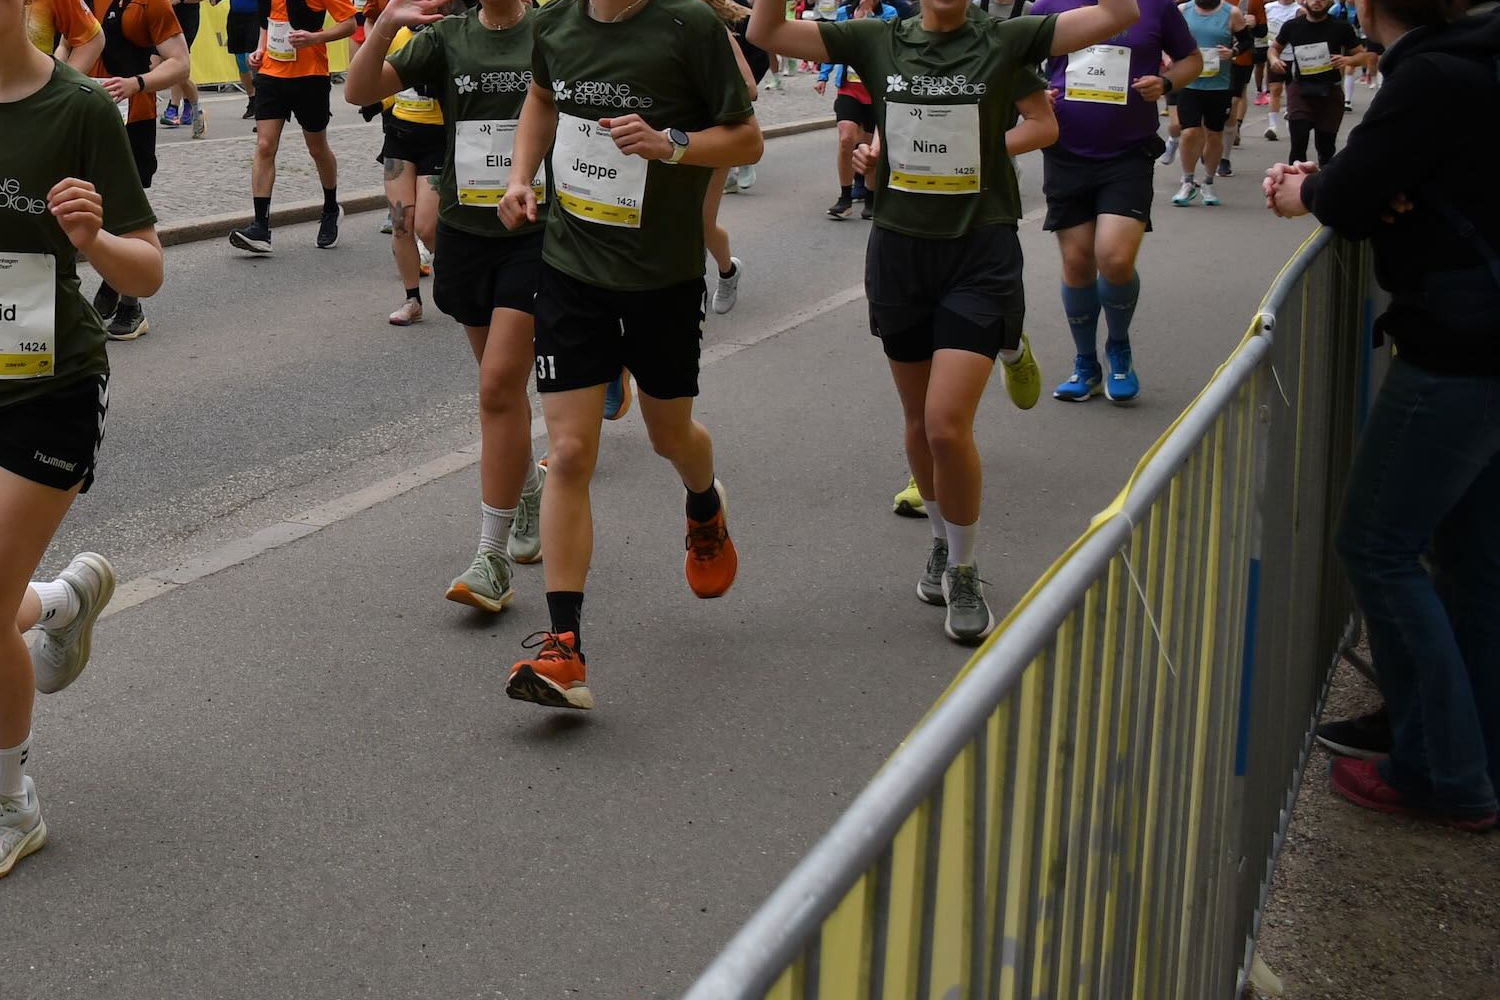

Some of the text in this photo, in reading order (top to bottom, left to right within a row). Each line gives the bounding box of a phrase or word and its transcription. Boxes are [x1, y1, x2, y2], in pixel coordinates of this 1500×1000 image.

[1087, 67, 1106, 76] Zak
[913, 140, 947, 153] Nina
[486, 155, 512, 167] Ella
[572, 158, 617, 179] Jeppe
[954, 167, 975, 175] 1425
[617, 197, 636, 208] 1421
[19, 342, 47, 352] 1424
[536, 355, 556, 379] 31
[33, 450, 78, 472] hummel
